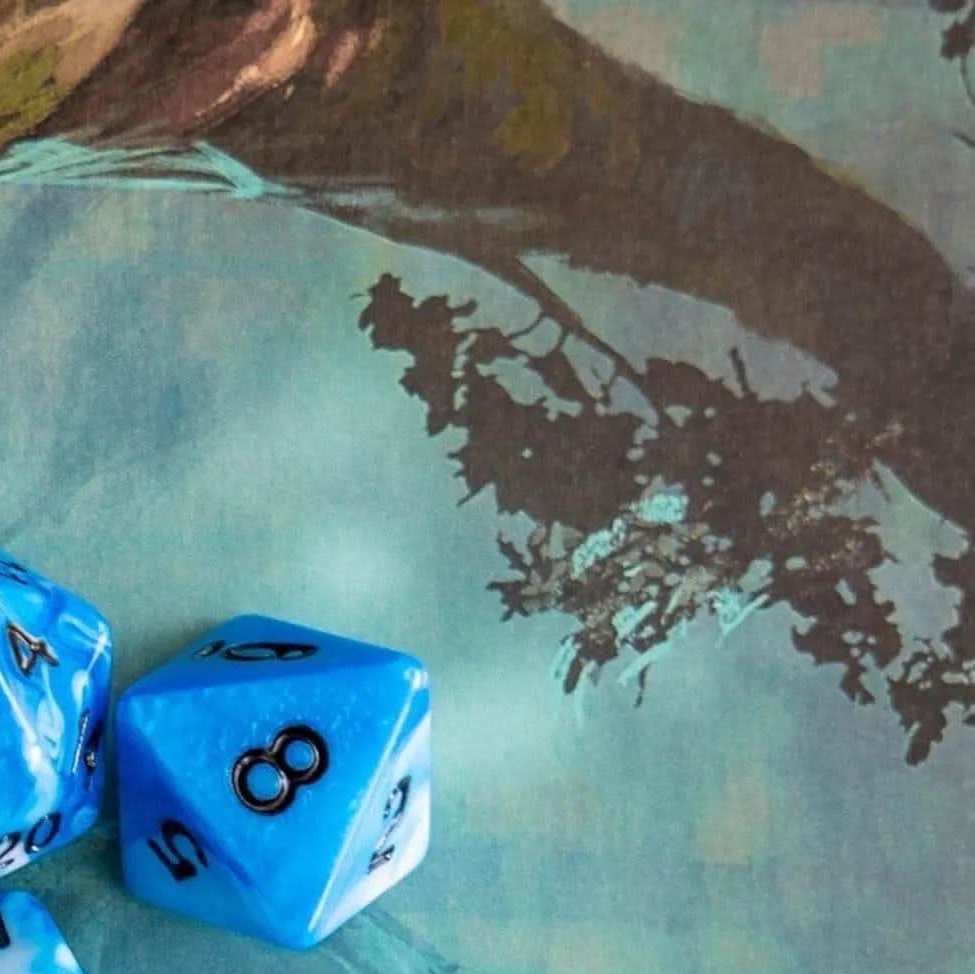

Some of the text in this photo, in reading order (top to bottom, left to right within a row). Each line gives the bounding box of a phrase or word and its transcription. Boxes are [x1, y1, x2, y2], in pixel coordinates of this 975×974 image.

[5, 619, 59, 678] 4
[231, 724, 330, 815] 8
[147, 817, 209, 882] 5
